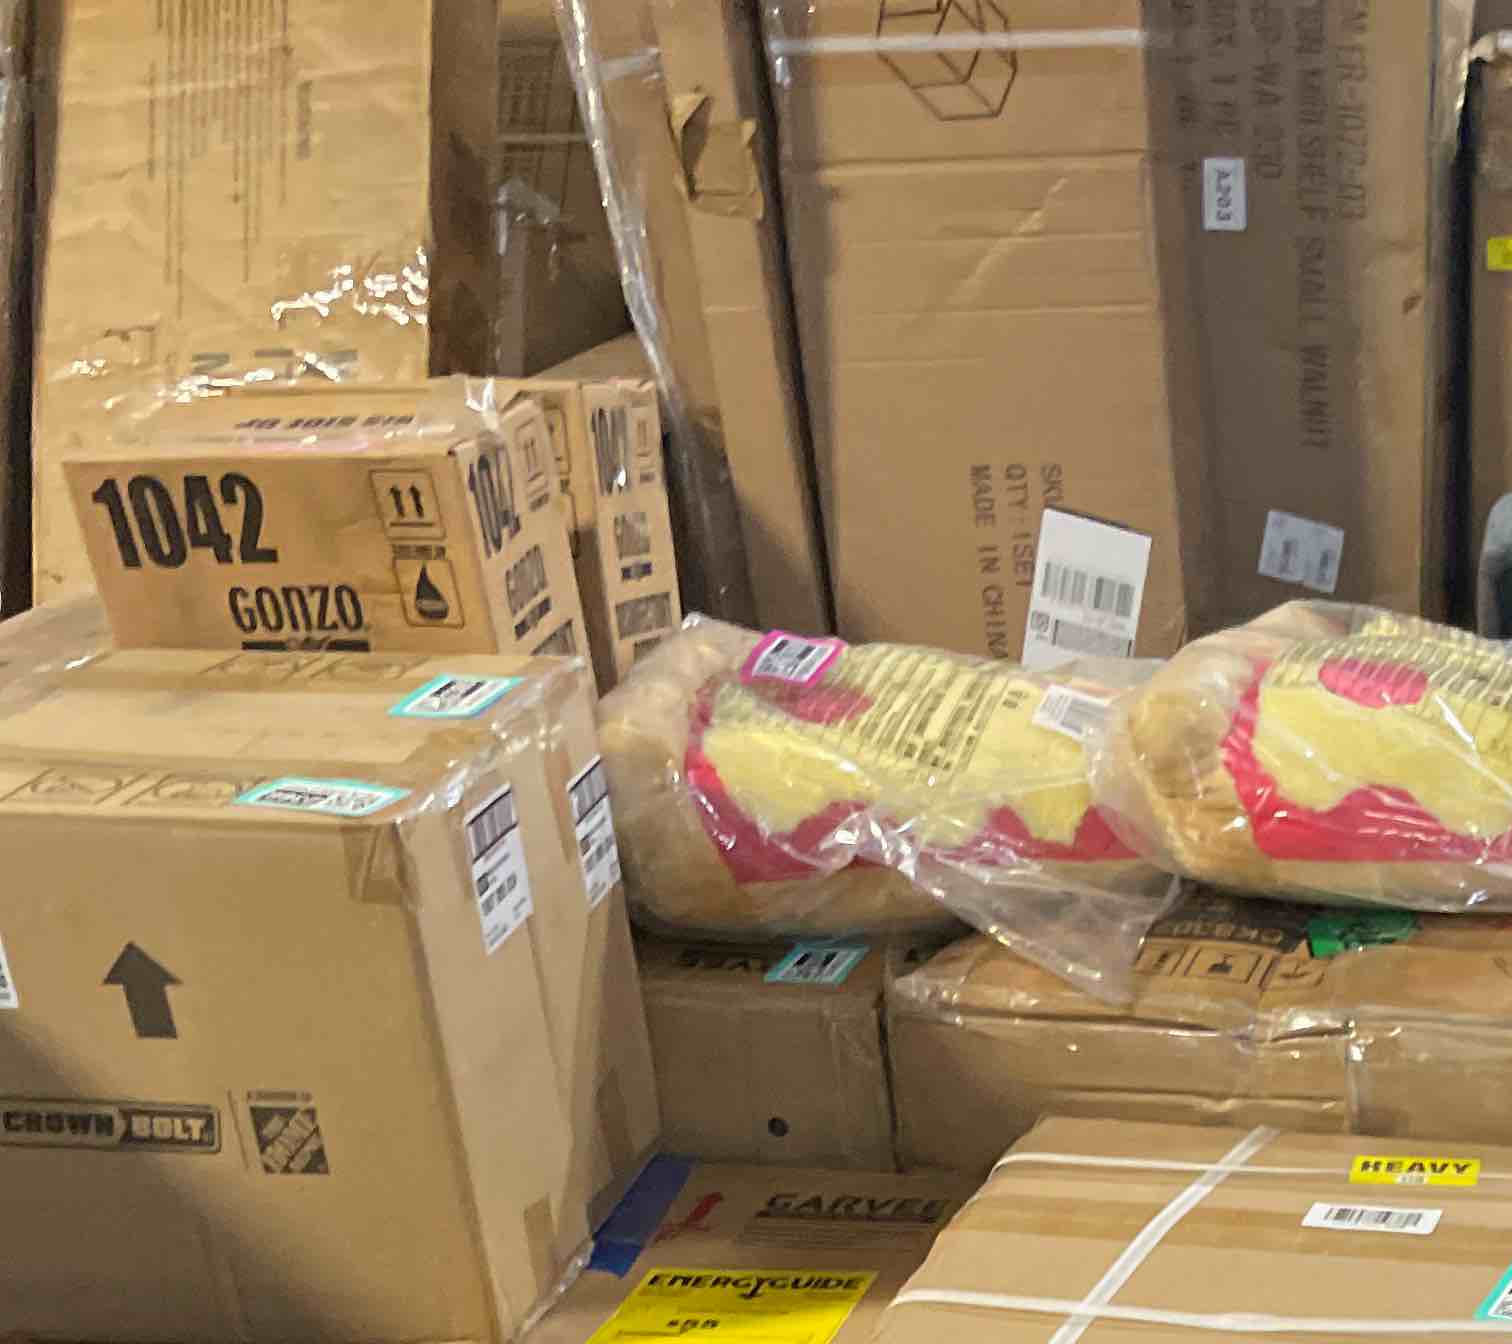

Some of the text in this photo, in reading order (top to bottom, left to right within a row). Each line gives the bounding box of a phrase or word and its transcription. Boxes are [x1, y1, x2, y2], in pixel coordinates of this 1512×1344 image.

[970, 463, 996, 528] MADE
[90, 470, 280, 570] 1042
[977, 545, 1001, 576] IN
[2, 1109, 206, 1143] CROWN BOLT
[1360, 1159, 1473, 1175] HEAVY
